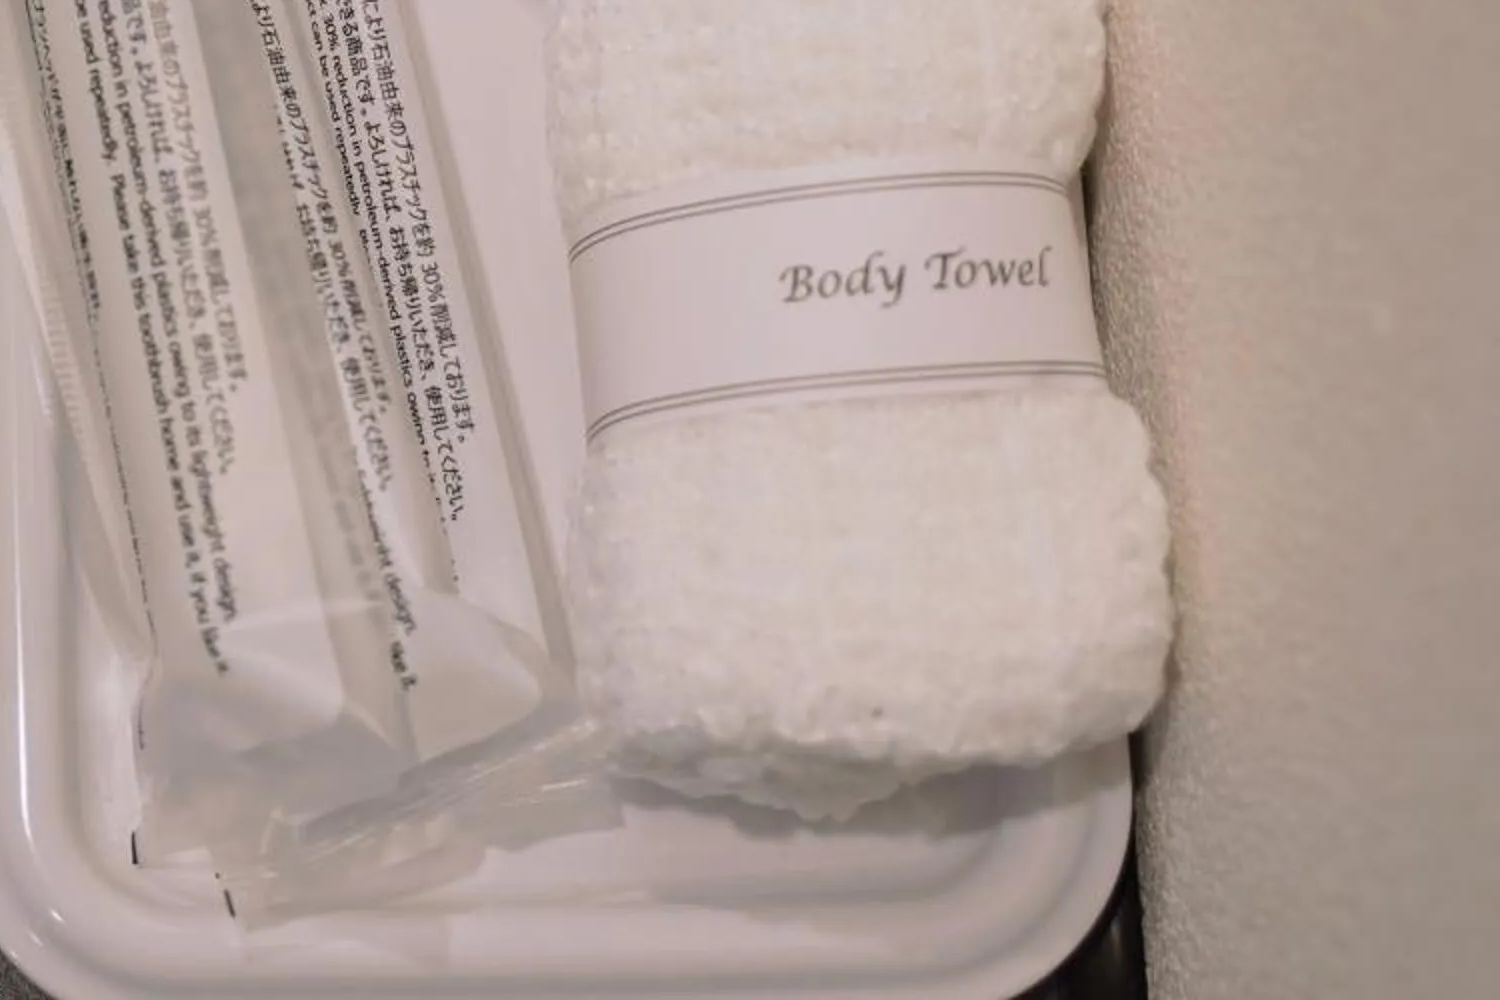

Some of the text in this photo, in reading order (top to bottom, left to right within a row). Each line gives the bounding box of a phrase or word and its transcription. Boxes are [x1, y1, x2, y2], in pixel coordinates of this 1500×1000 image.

[79, 21, 100, 65] used
[310, 20, 323, 52] can
[318, 54, 329, 77] be
[331, 54, 357, 137] reduction
[350, 138, 362, 157] in
[778, 245, 1053, 309] Body Towel
